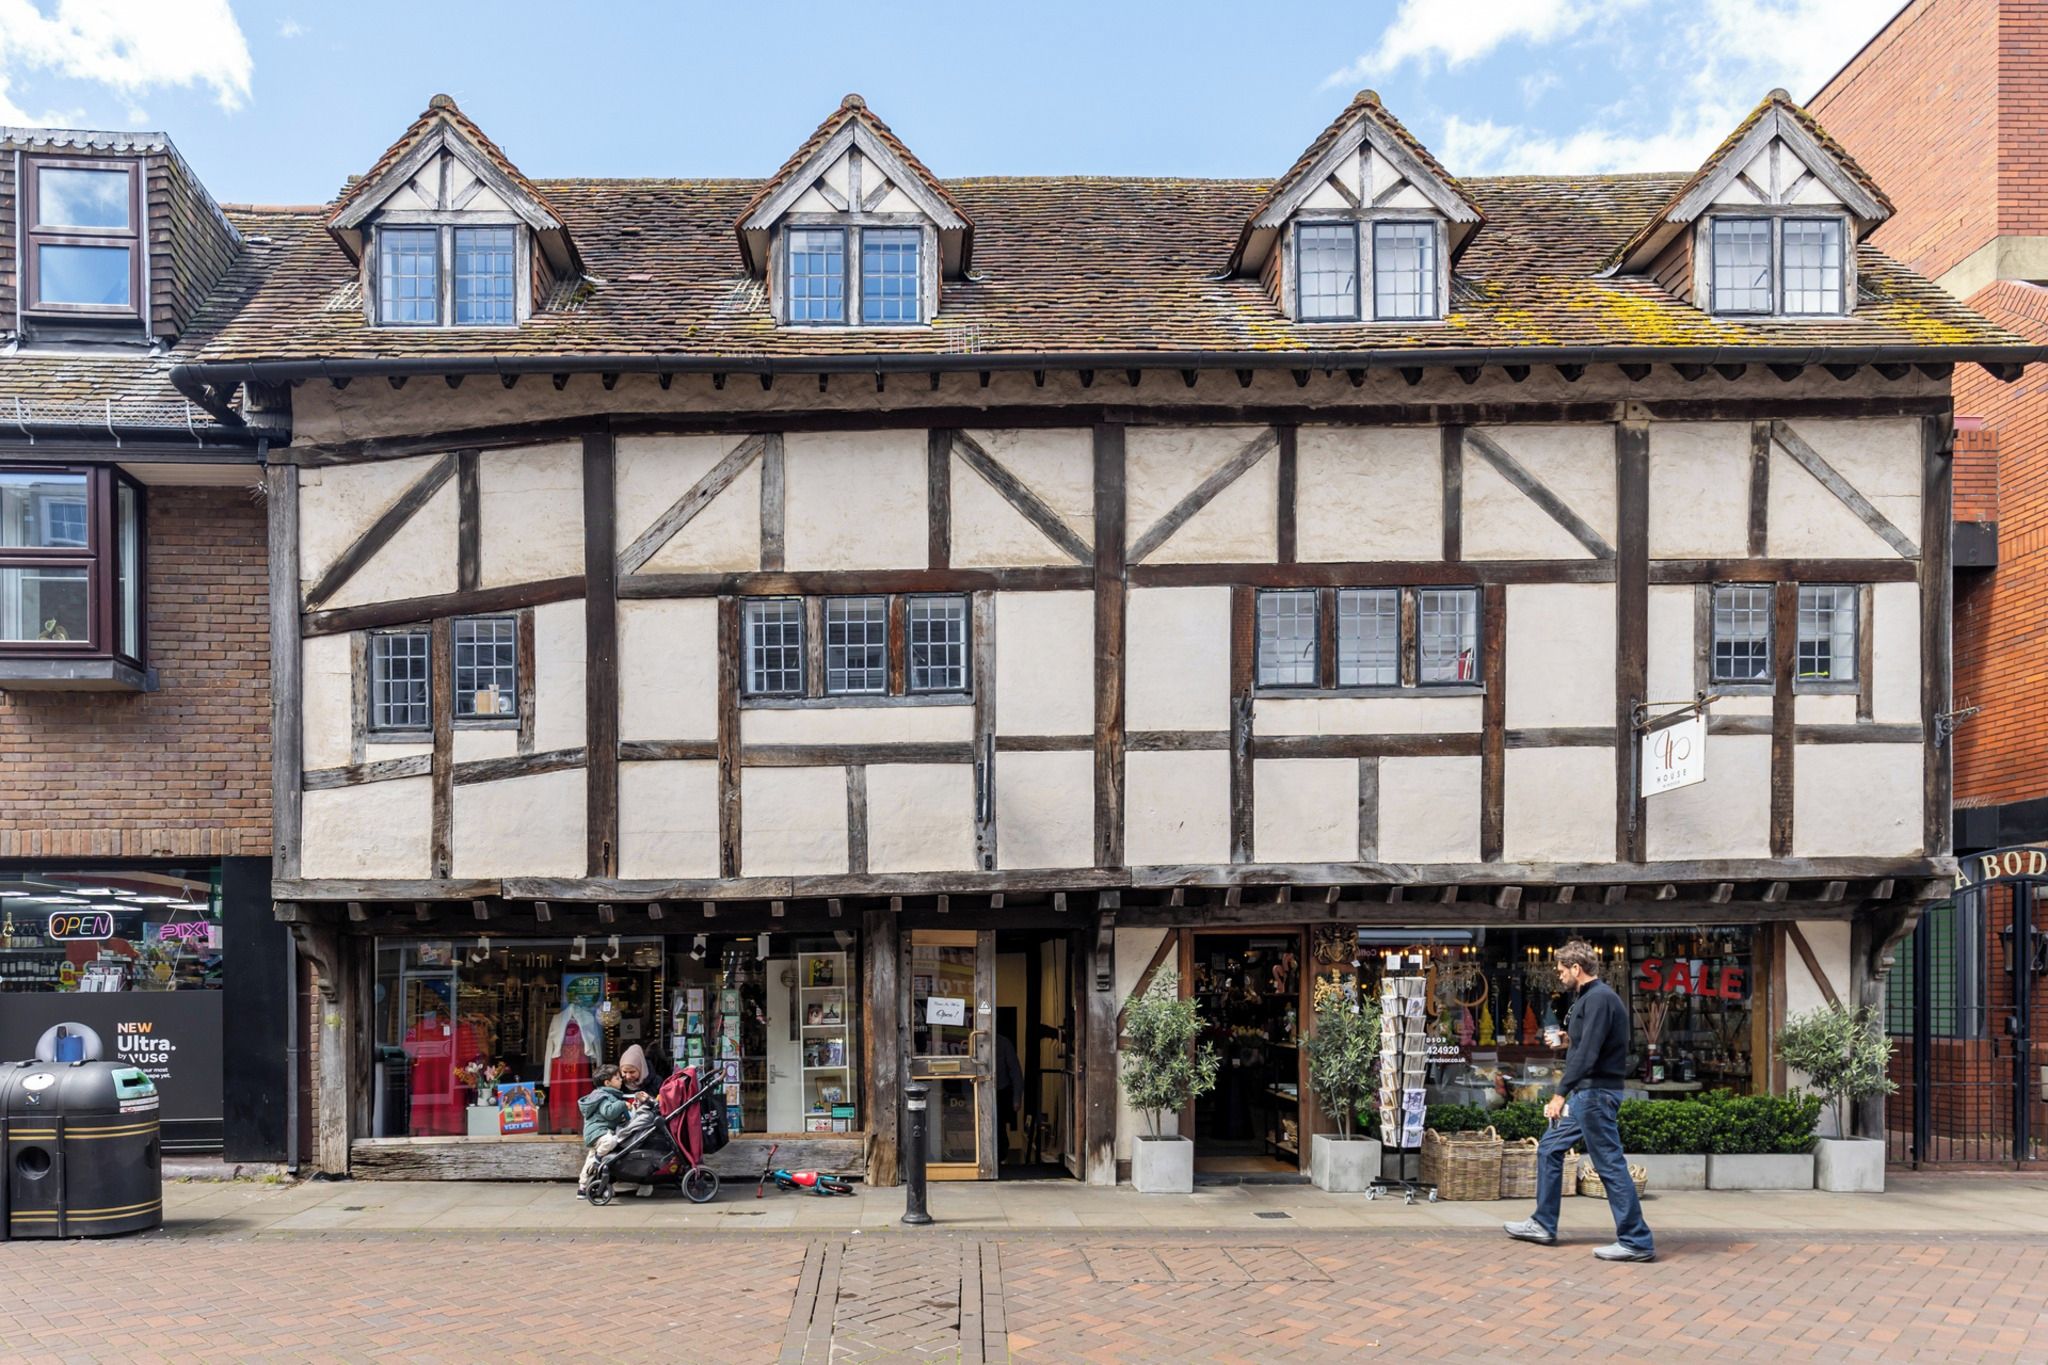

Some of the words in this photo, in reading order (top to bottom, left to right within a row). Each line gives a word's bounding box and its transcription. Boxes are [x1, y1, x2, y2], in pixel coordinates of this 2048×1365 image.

[1656, 768, 1688, 783] HOUSE
[51, 916, 110, 936] OPEN
[1638, 957, 1744, 999] SALE
[117, 1022, 152, 1033] NEW
[117, 1035, 176, 1051] Ultra.
